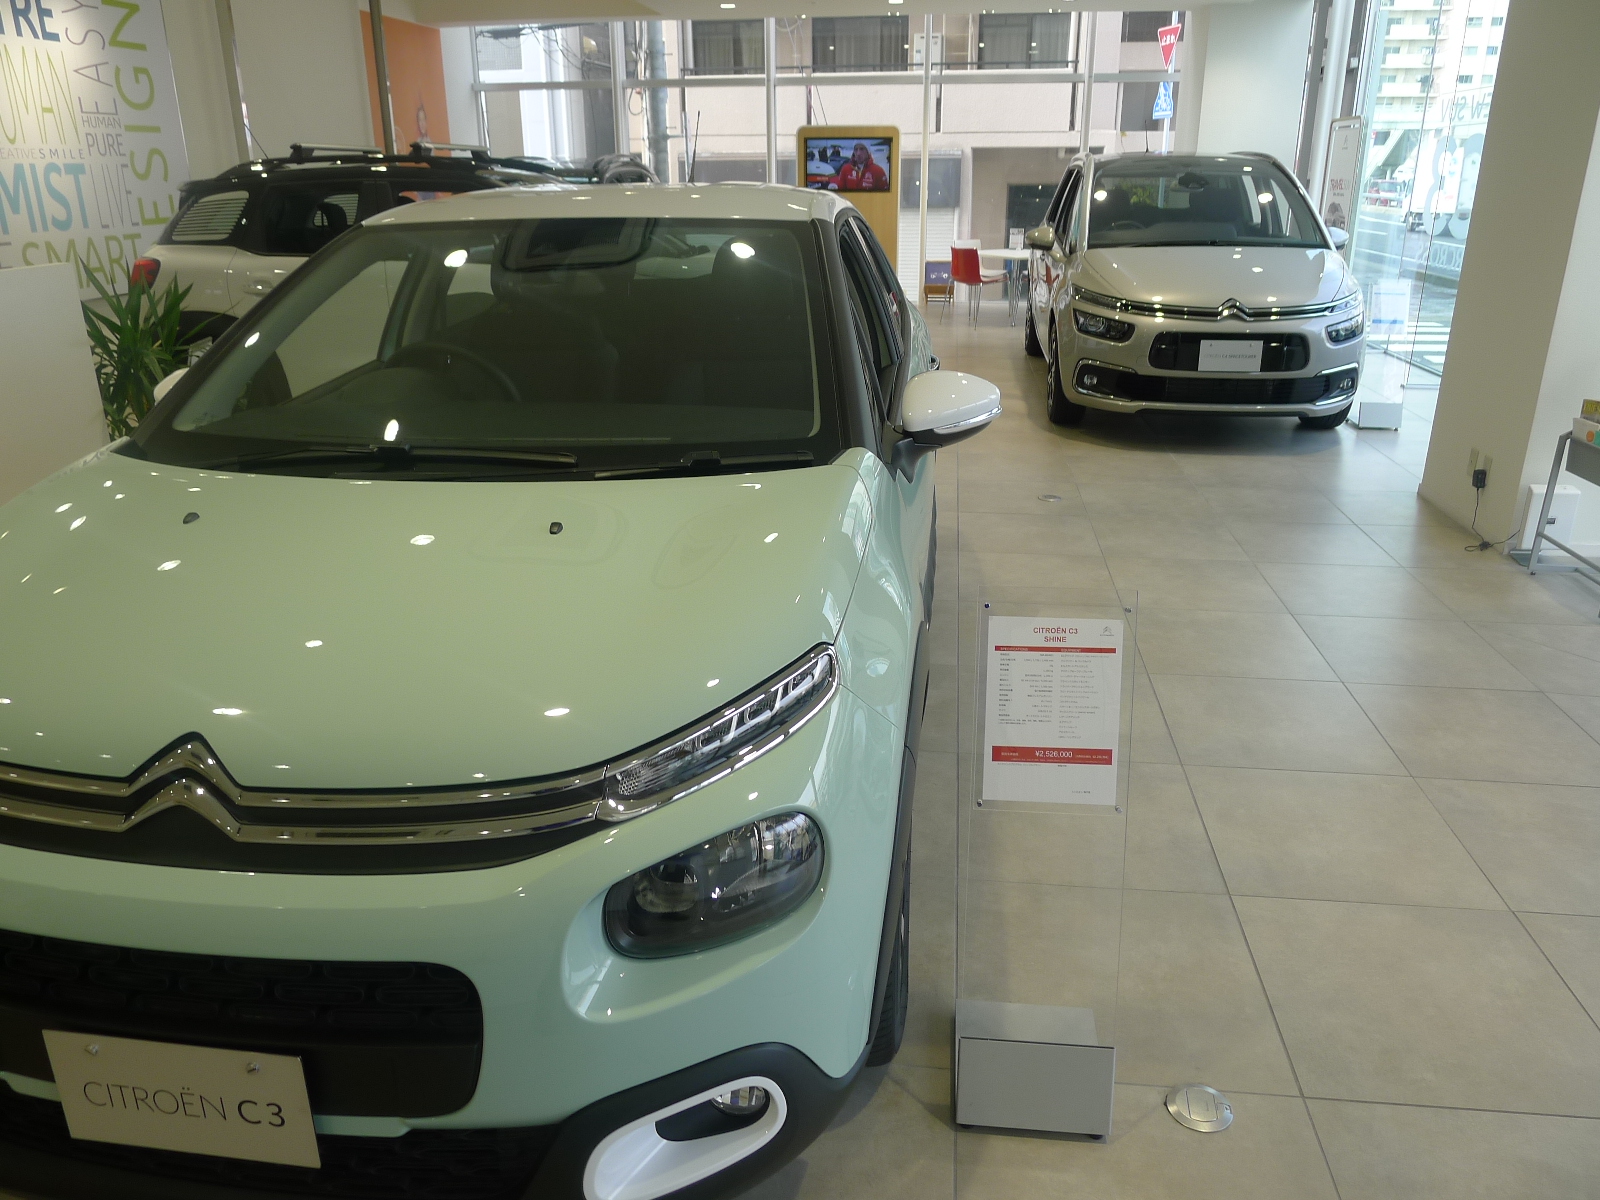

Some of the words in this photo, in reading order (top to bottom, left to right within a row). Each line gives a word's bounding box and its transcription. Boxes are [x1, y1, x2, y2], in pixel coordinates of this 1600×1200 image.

[62, 0, 118, 116] EASY
[82, 116, 122, 130] HUMAN
[103, 0, 176, 227] ESIGN
[39, 148, 86, 160] SMILE
[85, 132, 127, 158] PURE
[89, 163, 140, 230] LIVE
[1033, 626, 1067, 635] CITROËN
[1035, 750, 1073, 759] ¥2,526,000
[83, 1081, 227, 1121] CITROËN
[237, 1100, 286, 1127] C3
